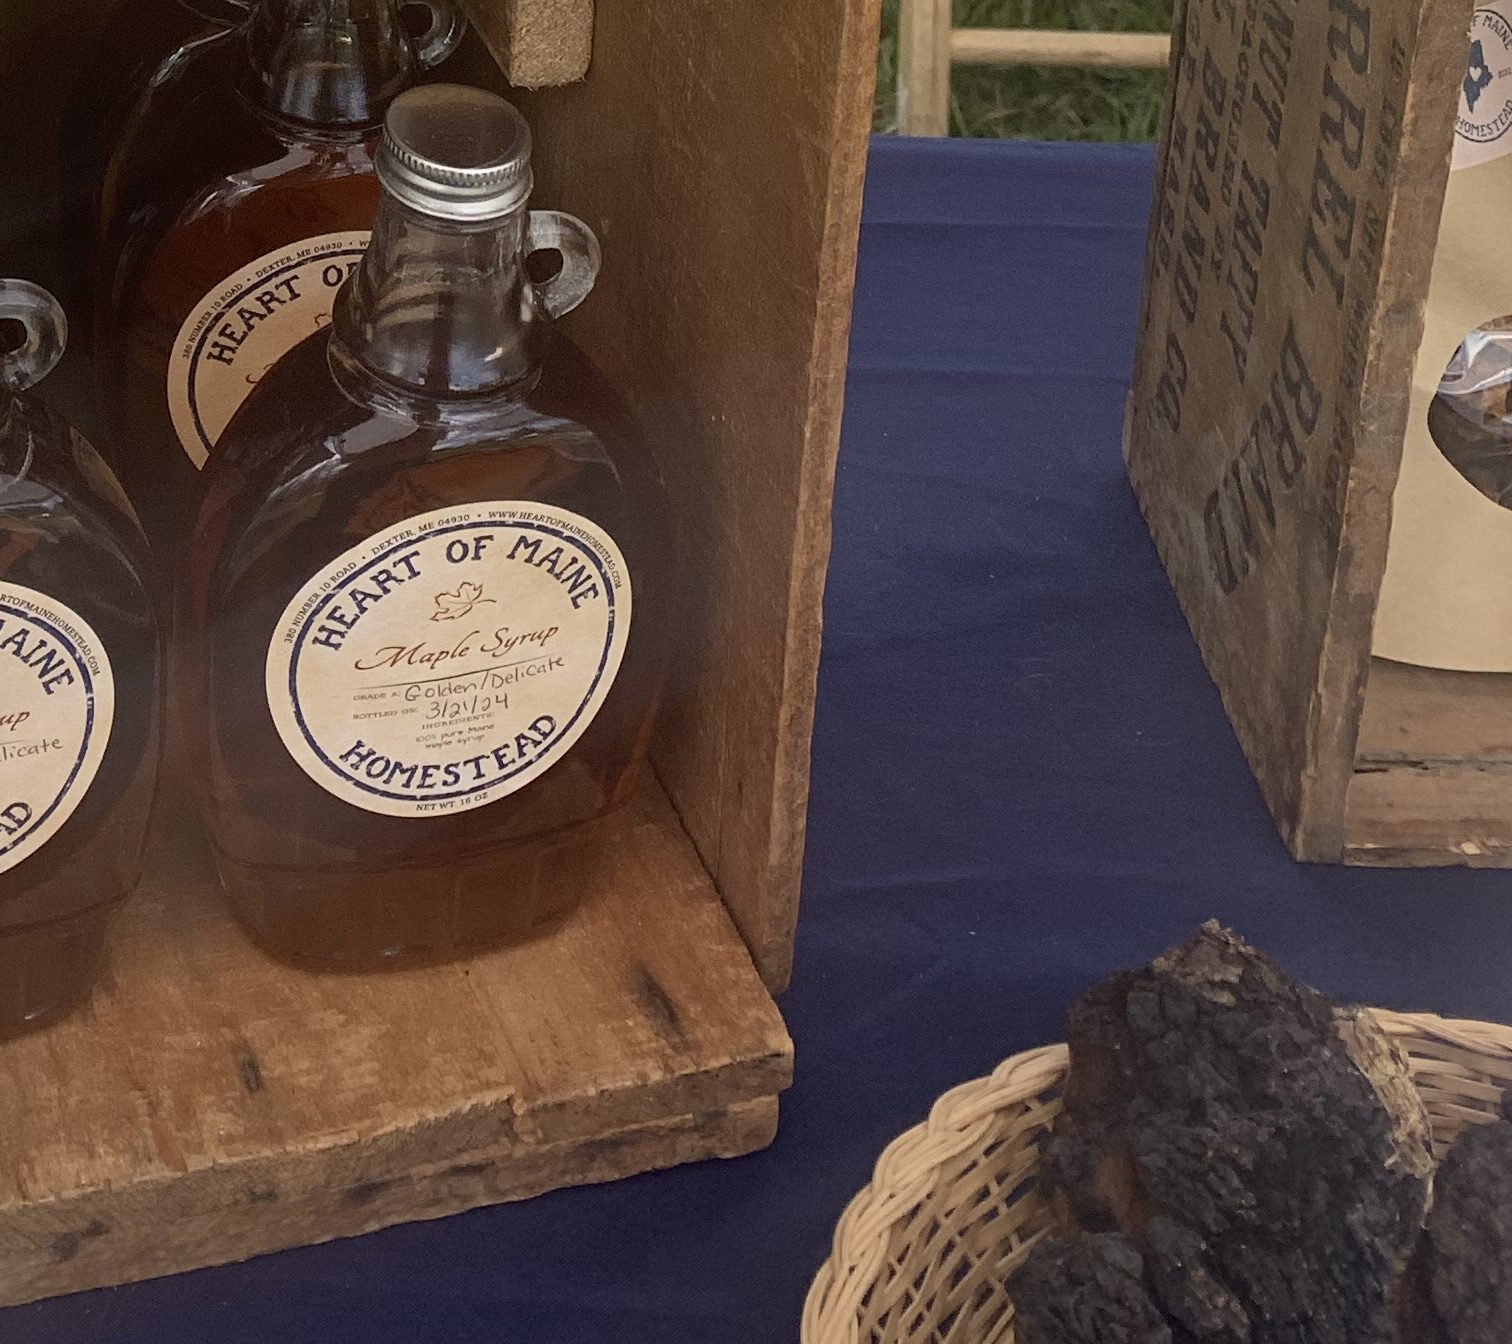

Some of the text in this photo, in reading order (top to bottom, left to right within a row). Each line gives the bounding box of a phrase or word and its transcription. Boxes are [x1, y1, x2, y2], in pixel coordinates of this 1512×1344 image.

[1175, 47, 1227, 322] BRAND
[206, 274, 301, 365] HEART
[1220, 160, 1271, 384] TAFFY
[1204, 317, 1323, 596] BRAND
[312, 533, 601, 651] HEART OF MAINE
[354, 627, 559, 671] Maple Syrup
[339, 715, 556, 789] HOMESTEAD
